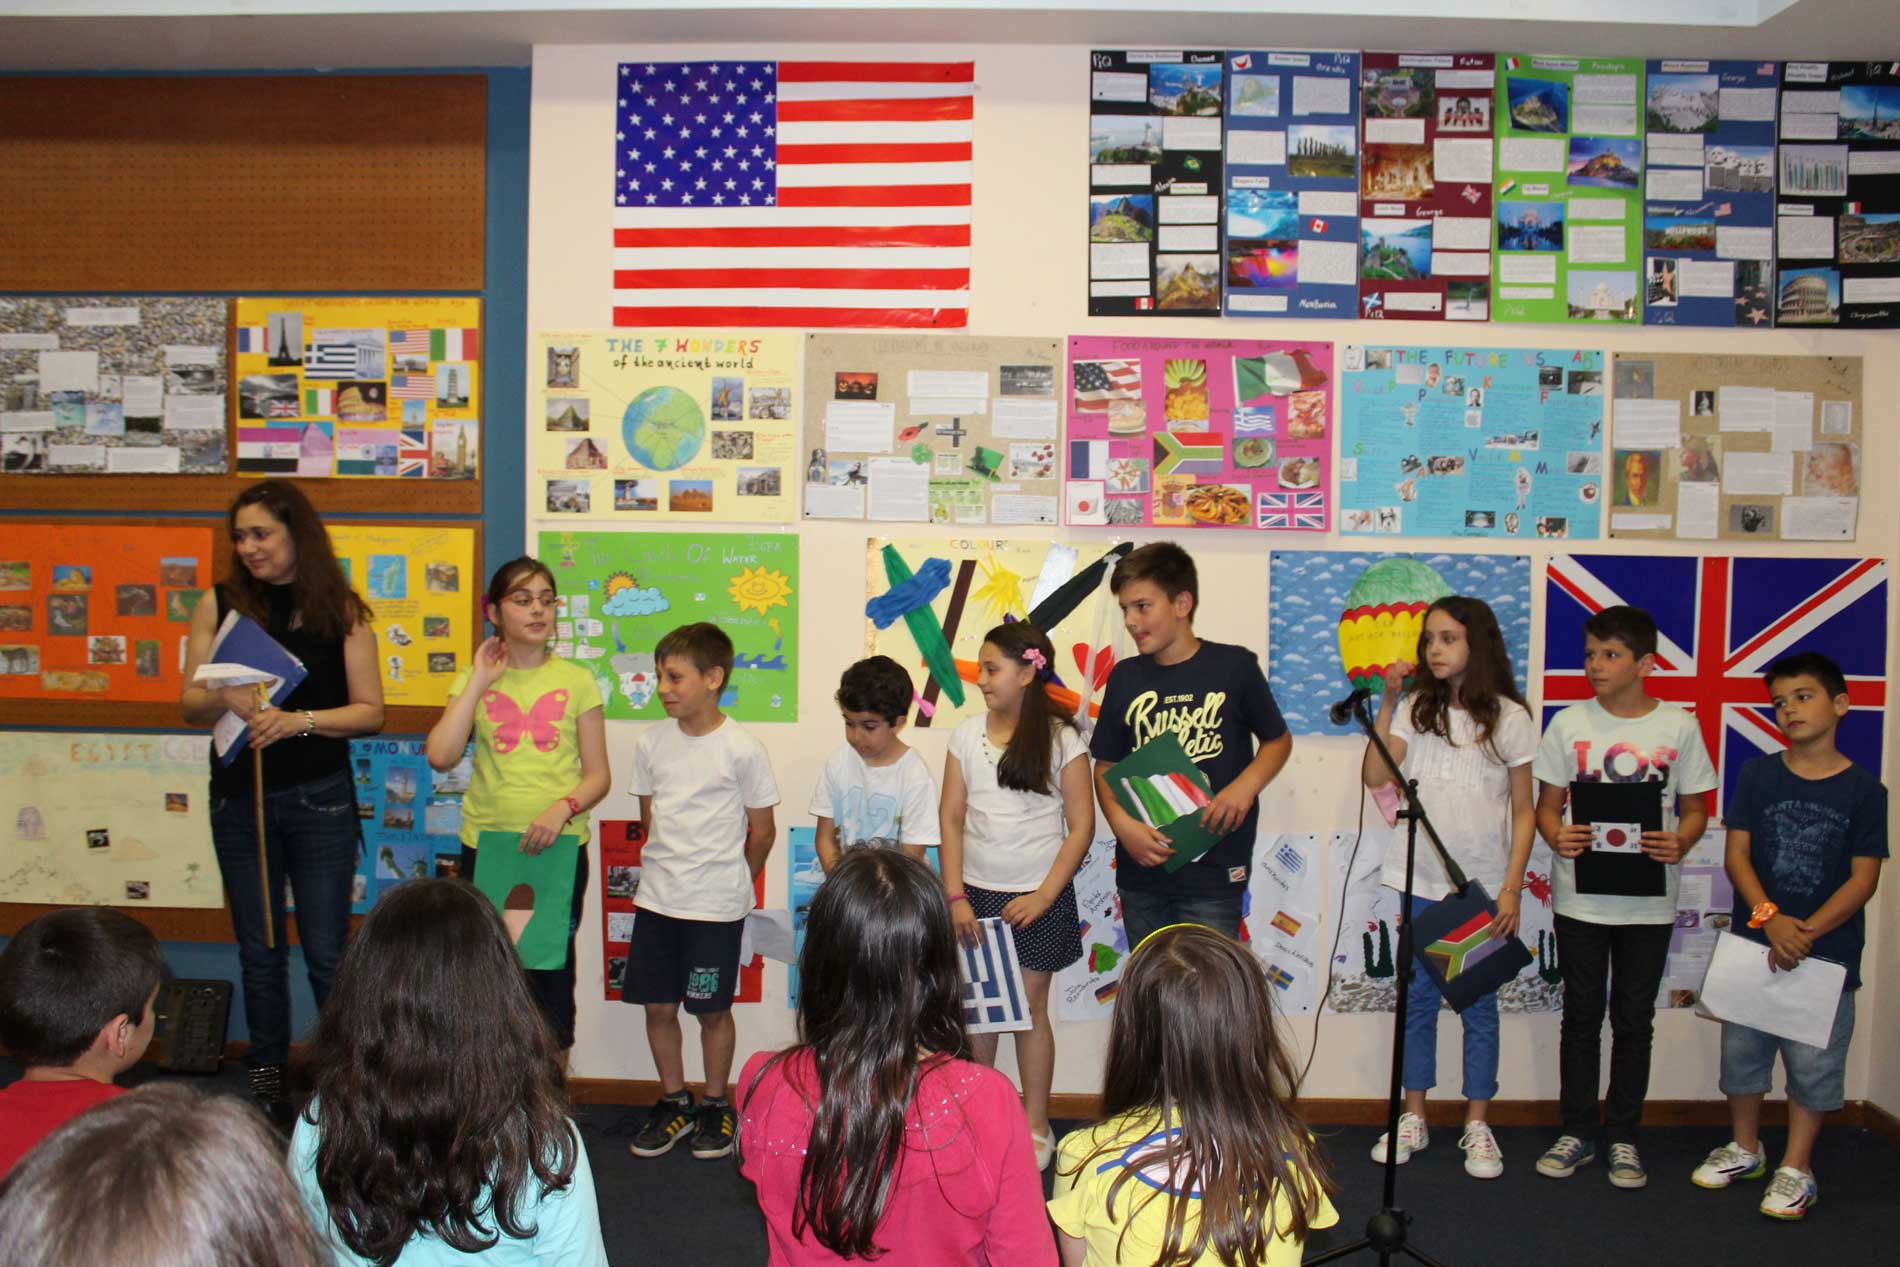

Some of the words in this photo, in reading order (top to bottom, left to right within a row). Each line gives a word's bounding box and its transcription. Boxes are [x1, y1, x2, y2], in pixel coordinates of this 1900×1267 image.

[606, 338, 643, 353] THE
[655, 339, 667, 353] 7
[675, 338, 762, 355] WONDERS
[613, 354, 628, 370] of
[633, 355, 653, 367] the
[657, 357, 711, 370] ancient
[716, 357, 754, 369] world
[1396, 350, 1428, 365] THE
[1445, 350, 1508, 369] FUTURE
[1125, 690, 1226, 752] Russell
